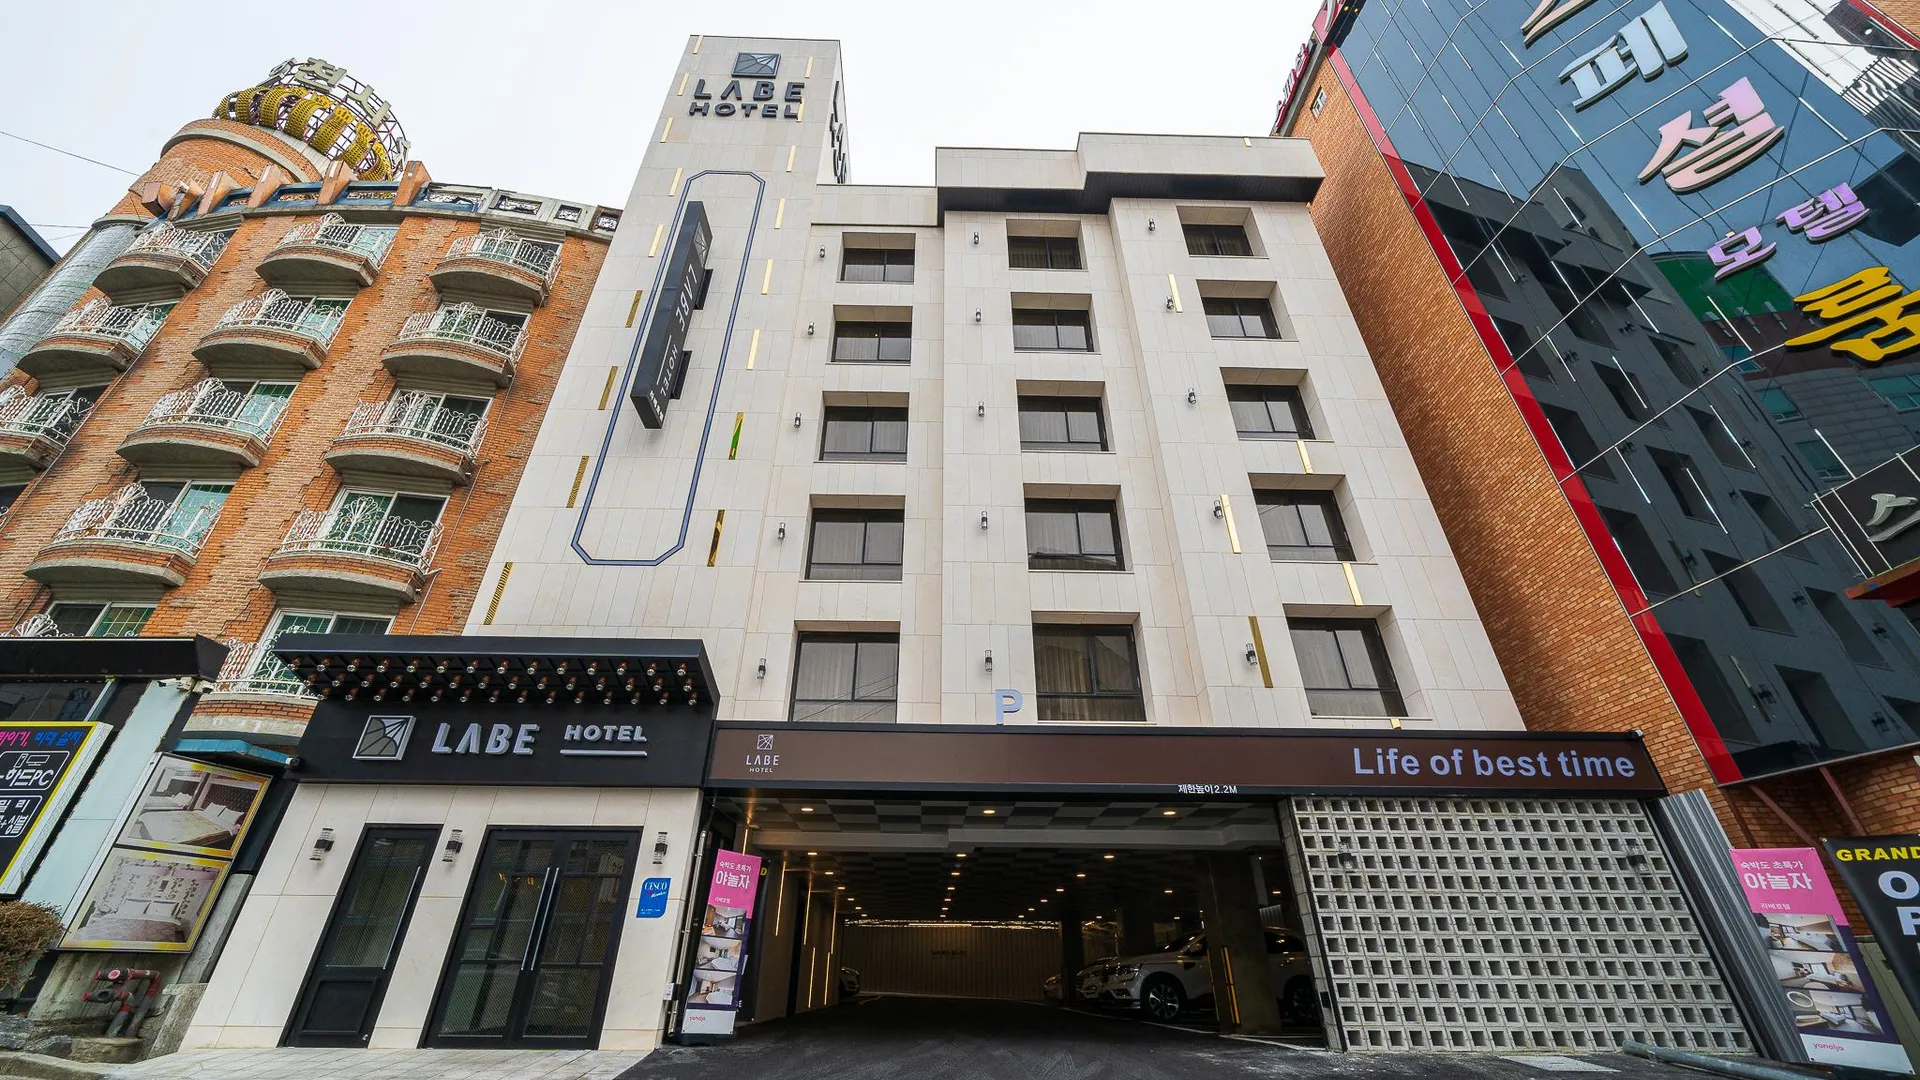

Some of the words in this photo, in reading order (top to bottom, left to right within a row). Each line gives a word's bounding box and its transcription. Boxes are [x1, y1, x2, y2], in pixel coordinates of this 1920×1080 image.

[694, 78, 805, 103] LABE
[689, 101, 799, 119] HOTEL
[1706, 182, 1870, 282] 모텔
[675, 263, 698, 332] LABE
[659, 343, 679, 397] HOTEL
[995, 688, 1023, 726] P
[431, 722, 540, 756] LABE
[564, 724, 647, 743] HOTEL
[745, 754, 780, 766] LABE
[1353, 747, 1420, 776] Life
[1430, 748, 1463, 776] of
[1472, 749, 1551, 778] best
[1557, 750, 1636, 778] time
[0, 768, 54, 788] 하드PC
[1740, 861, 1771, 870] 숙박도
[1773, 860, 1804, 870] 초특가
[715, 870, 751, 889] 야놀자
[1744, 872, 1813, 890] 야놀자
